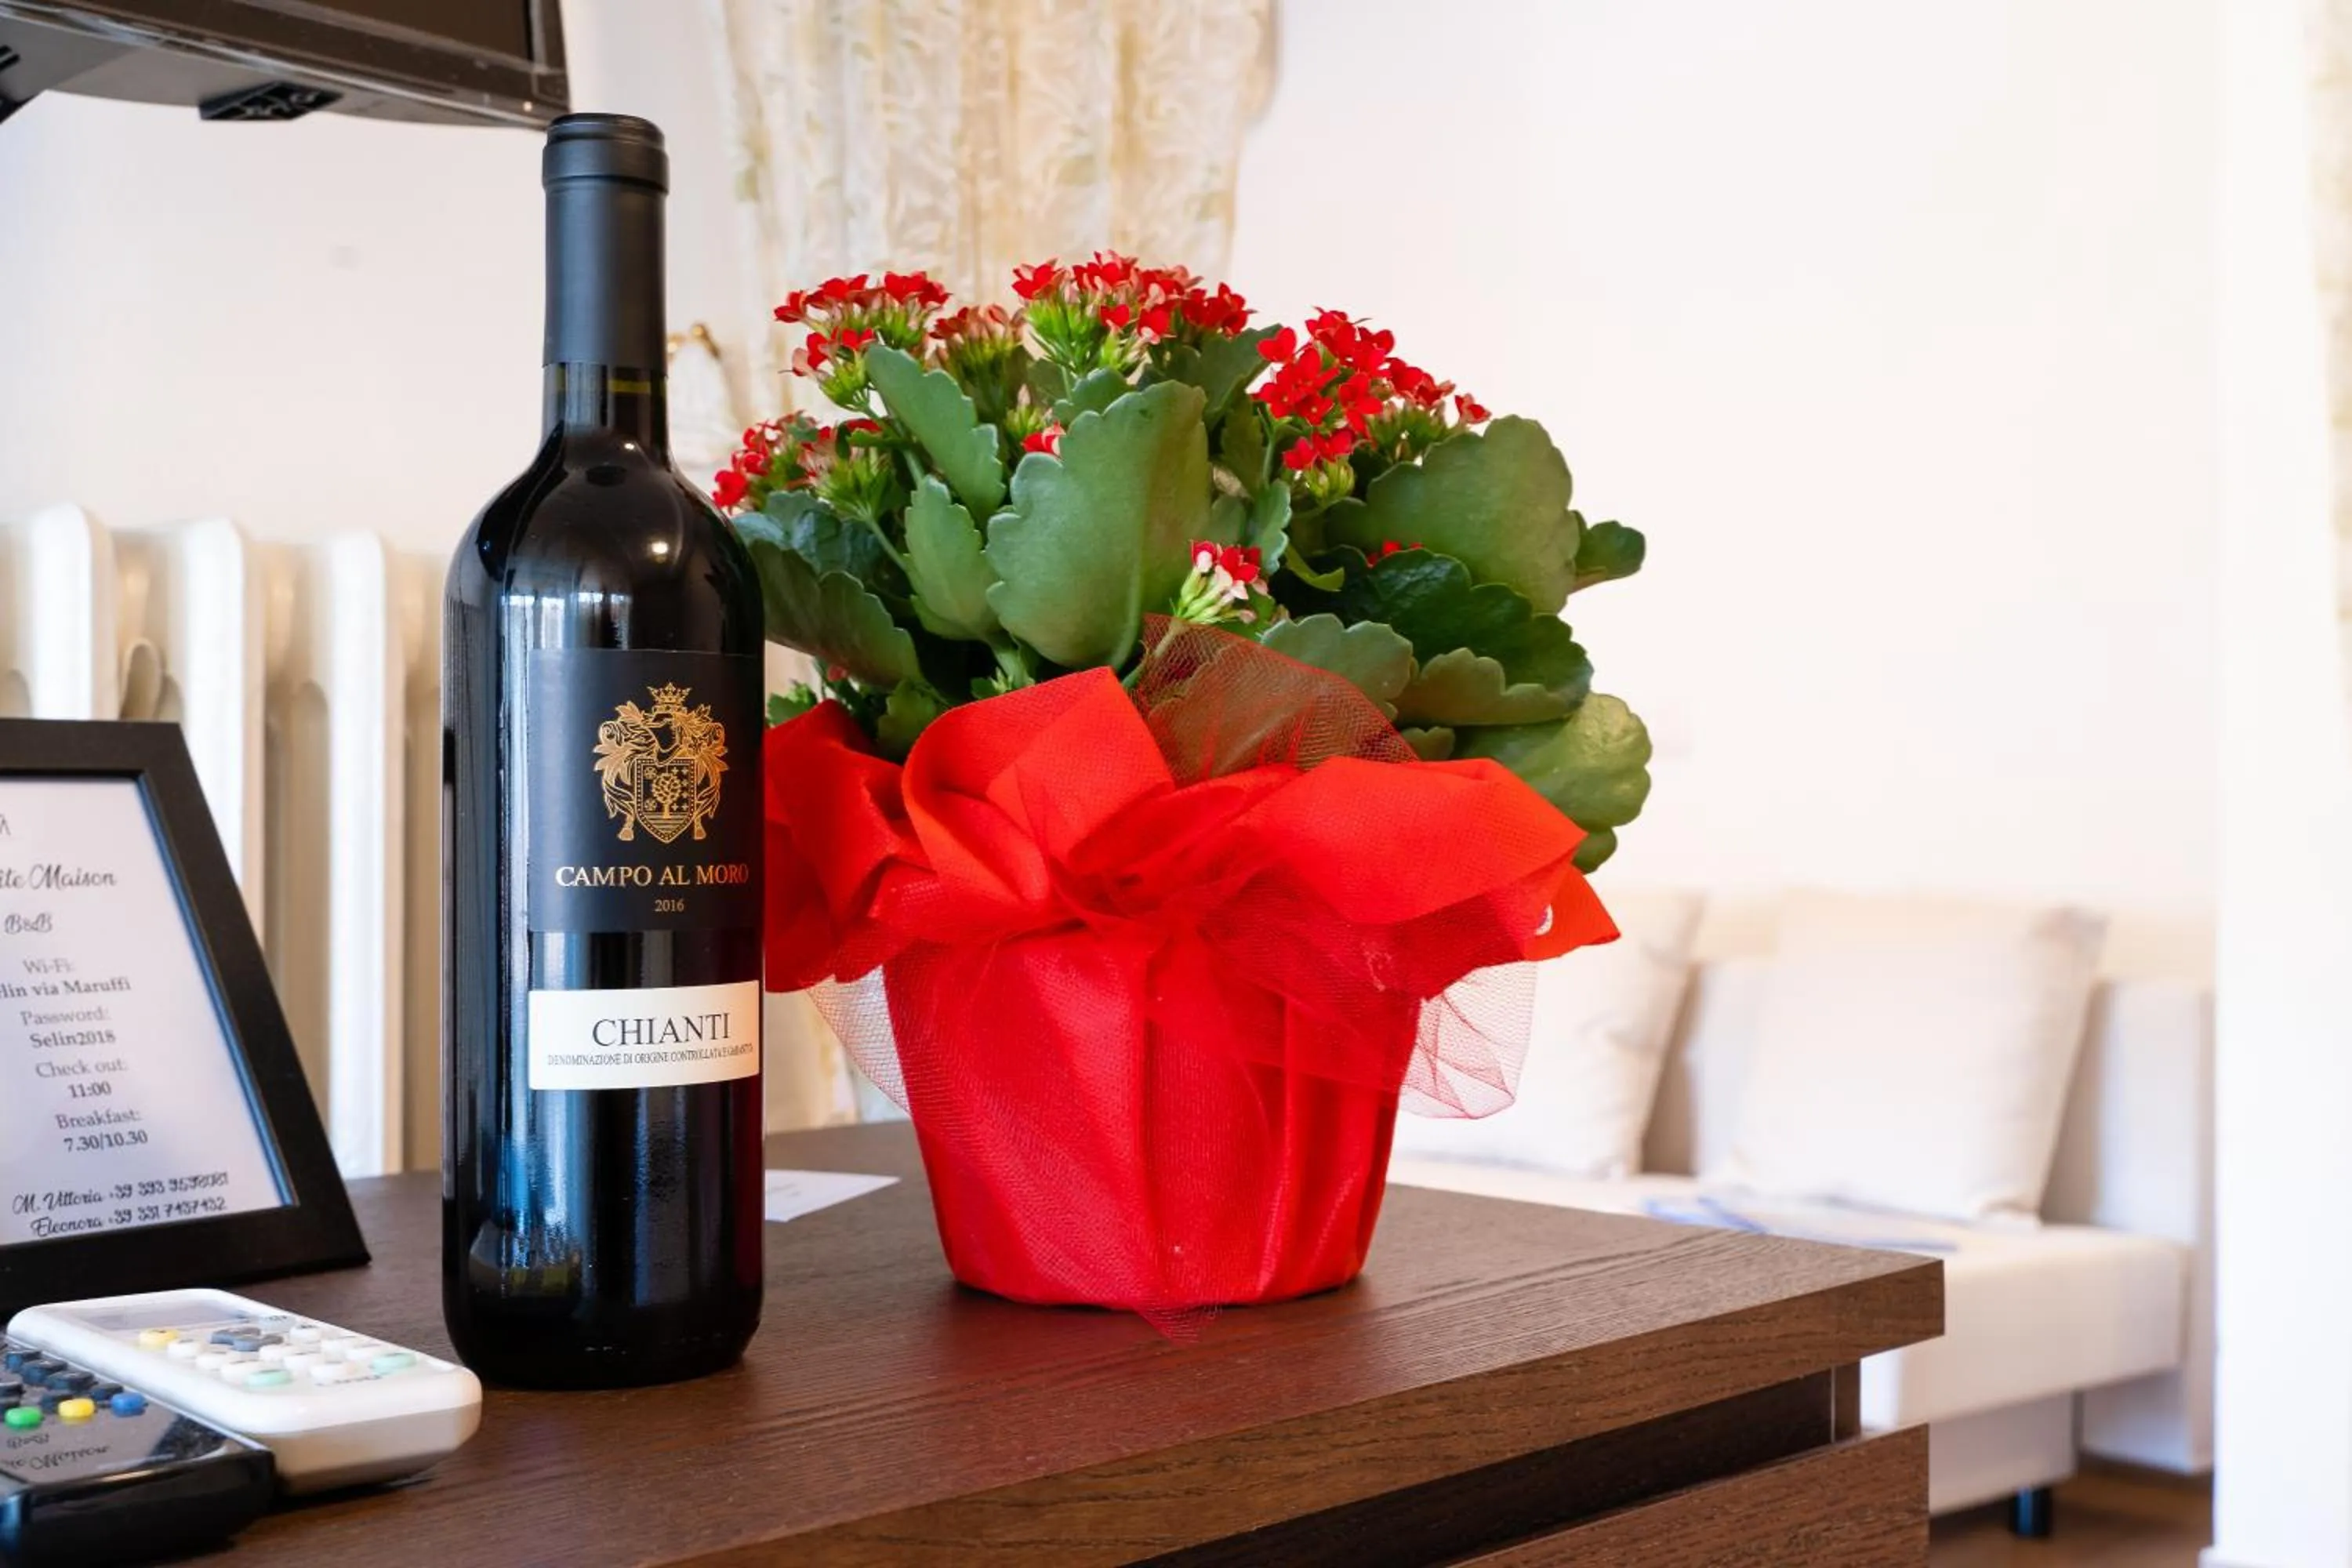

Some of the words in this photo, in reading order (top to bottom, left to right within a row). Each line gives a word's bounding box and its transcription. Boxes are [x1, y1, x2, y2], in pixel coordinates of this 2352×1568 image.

[29, 863, 117, 890] Maison
[555, 865, 652, 887] CAMPO
[659, 865, 690, 885] AL
[696, 863, 749, 884] MORO
[655, 899, 684, 912] 2016
[4, 913, 53, 935] B&B
[31, 982, 59, 996] via
[63, 977, 131, 994] Maruffi
[30, 1030, 116, 1048] Selin2018
[592, 1013, 730, 1047] CHIANTI
[35, 1060, 90, 1078] Check
[548, 1053, 622, 1065] DENOMINAZIONE
[67, 1080, 111, 1098] 11:00
[63, 1129, 148, 1152] 7.30/10.30
[31, 1216, 103, 1237] Eleonora
